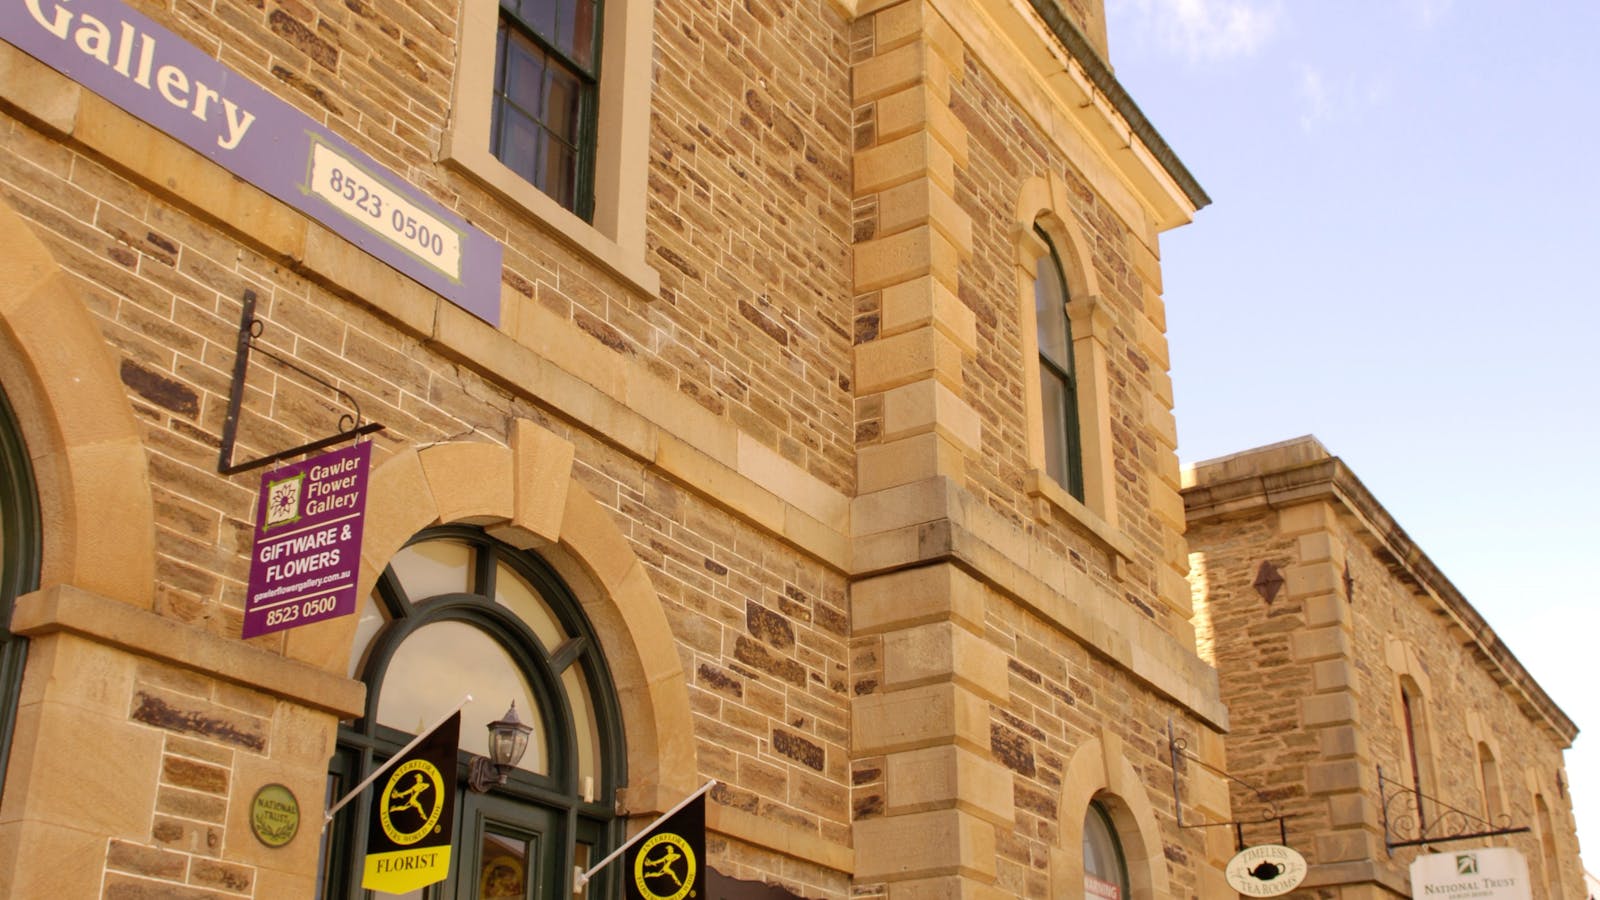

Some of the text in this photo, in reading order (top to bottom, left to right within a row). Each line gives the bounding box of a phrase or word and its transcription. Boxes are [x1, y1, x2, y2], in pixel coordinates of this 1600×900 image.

[24, 0, 255, 150] Gallery
[330, 168, 443, 257] 8523 0500
[310, 457, 360, 481] Gawler
[307, 475, 357, 499] Flower
[306, 492, 359, 516] Gallery
[260, 524, 352, 563] GIFTWARE &
[266, 549, 340, 583] FLOWERS
[253, 570, 351, 603] gawlerflowergallery.com.au
[266, 595, 336, 626] 8523 0500
[391, 761, 435, 782] INTERFLORA
[258, 798, 296, 814] NATIONAL
[264, 810, 288, 823] TRUST
[643, 833, 686, 852] INTERFLORA
[376, 853, 438, 873] FLORIST
[1242, 847, 1288, 864] TIMELESS
[1424, 881, 1480, 896] NATIONAL
[1483, 877, 1516, 889] TRUST
